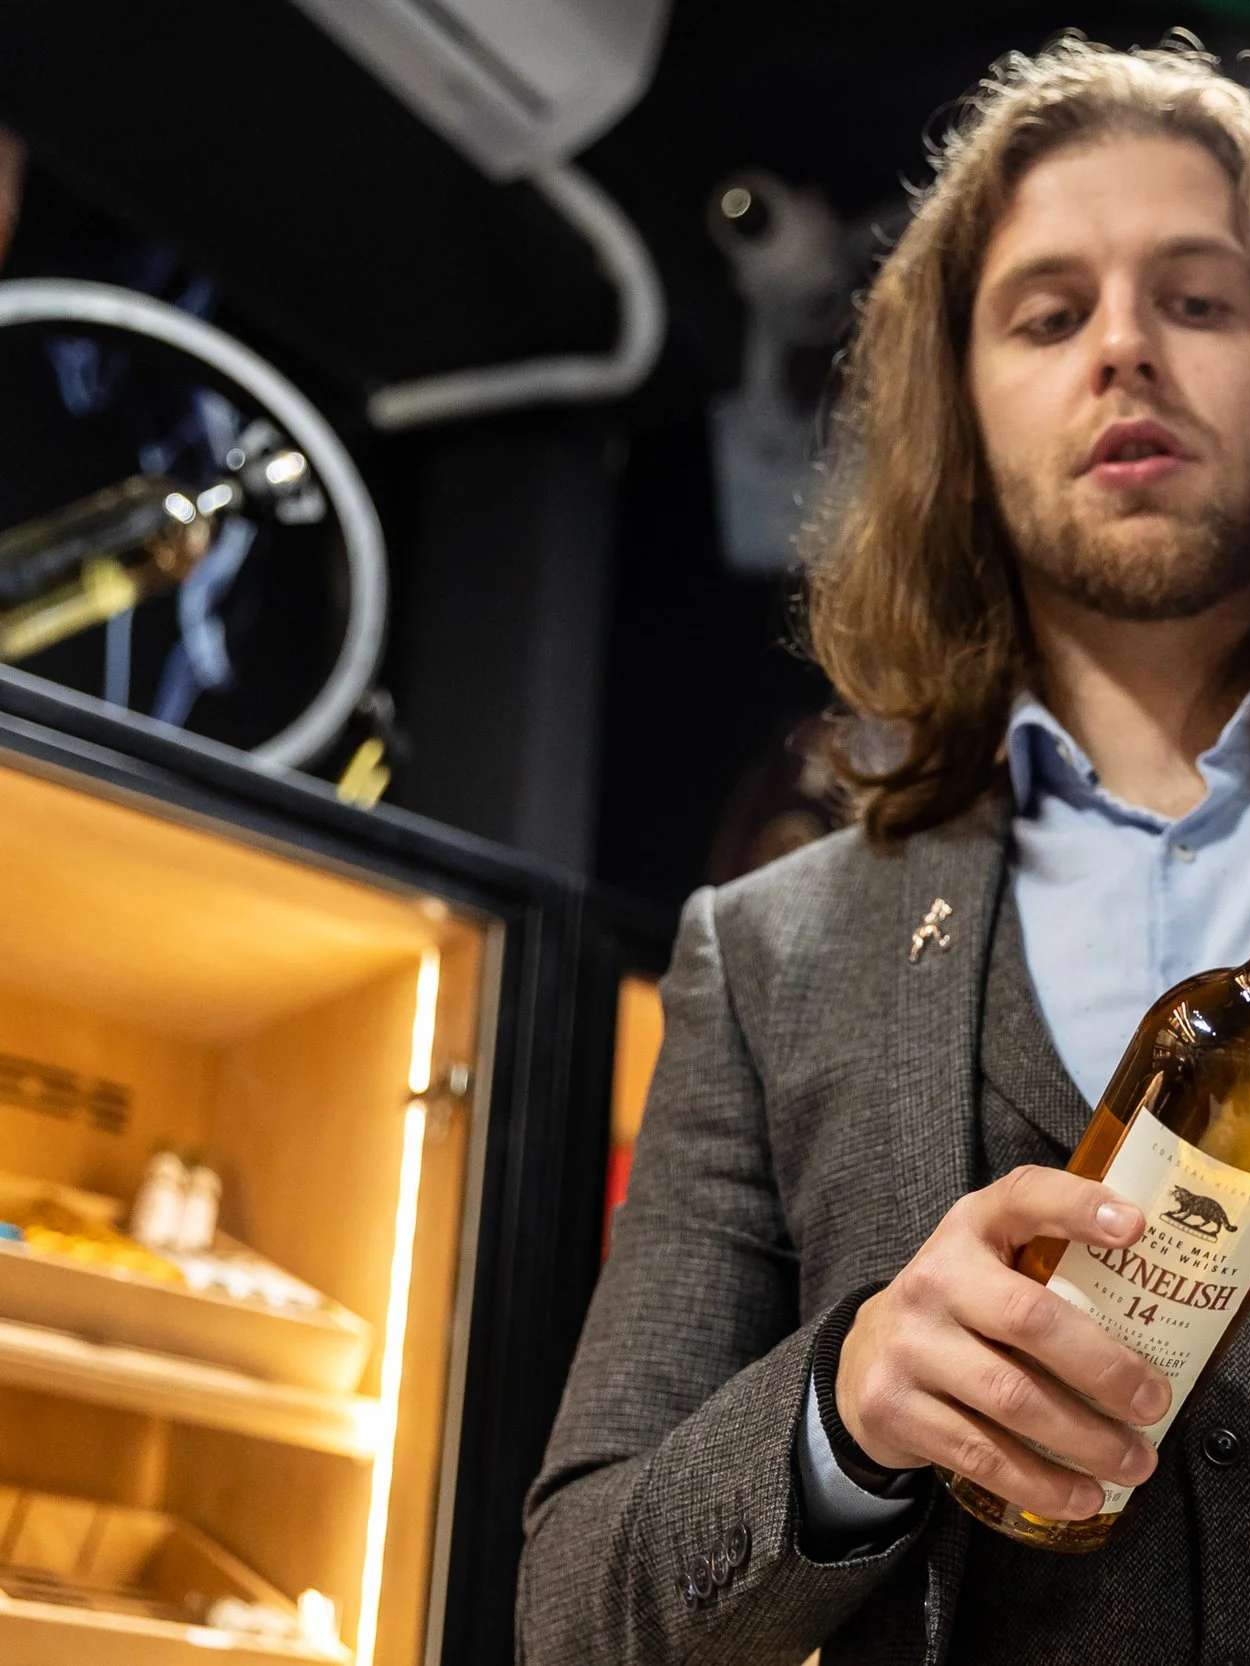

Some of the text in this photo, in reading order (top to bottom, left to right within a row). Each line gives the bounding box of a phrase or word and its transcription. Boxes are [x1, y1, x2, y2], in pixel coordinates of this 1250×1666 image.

[1152, 1143, 1205, 1182] COASTAL
[1141, 1234, 1238, 1276] TCH WHISKY
[1148, 1226, 1184, 1249] NGLE
[1191, 1247, 1227, 1264] MALT
[1094, 1282, 1191, 1329] AGED 14 YEARS
[1090, 1307, 1143, 1338] DISTILLED
[1150, 1337, 1170, 1347] AND
[1136, 1341, 1191, 1358] SCOTLAND
